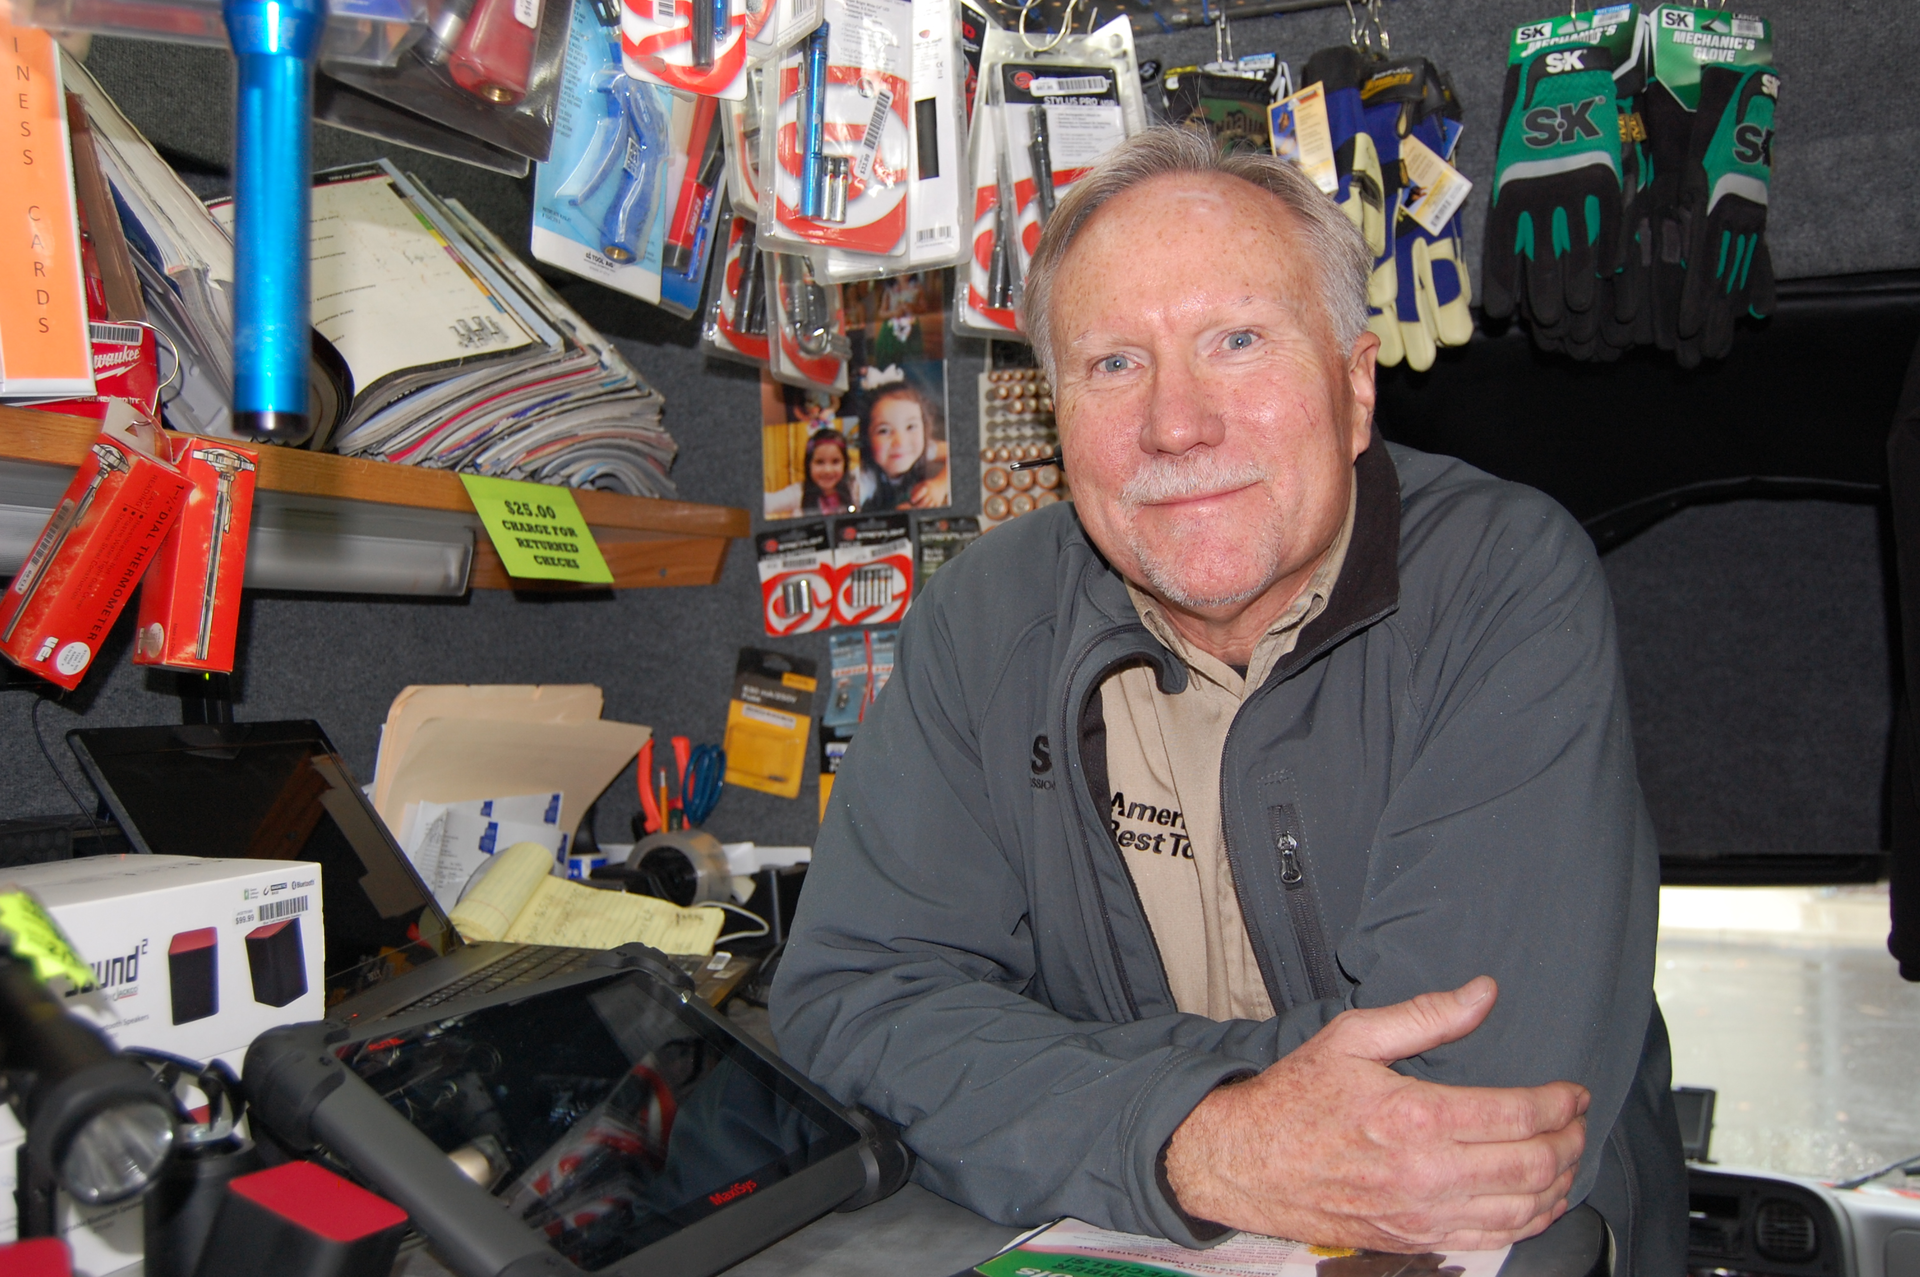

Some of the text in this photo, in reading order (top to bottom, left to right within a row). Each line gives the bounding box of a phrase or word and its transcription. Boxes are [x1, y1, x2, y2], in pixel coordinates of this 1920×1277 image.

[1665, 12, 1689, 28] SK
[1521, 25, 1545, 40] SK
[1673, 30, 1756, 51] MECHANIC'S
[1545, 49, 1586, 74] SK
[1692, 46, 1736, 62] GLOVE
[1043, 96, 1078, 105] STYLUS
[1079, 96, 1098, 106] PRO
[1523, 97, 1604, 148] SK
[28, 205, 51, 334] CARDS
[92, 345, 141, 371] waukee
[135, 473, 158, 507] READING
[142, 490, 158, 510] EASY
[504, 500, 556, 519] $25.00
[144, 510, 168, 542] DIAL
[502, 519, 578, 538] CHARGE FOR
[515, 537, 579, 553] RETURNED
[533, 555, 580, 569] CHECKS
[84, 542, 150, 642] THERMOMETER
[235, 914, 255, 925] $99.99
[708, 1178, 758, 1206] MaxiSys
[1064, 1257, 1165, 1277] ECIALS!
[1219, 1267, 1278, 1277] AMERICA'S
